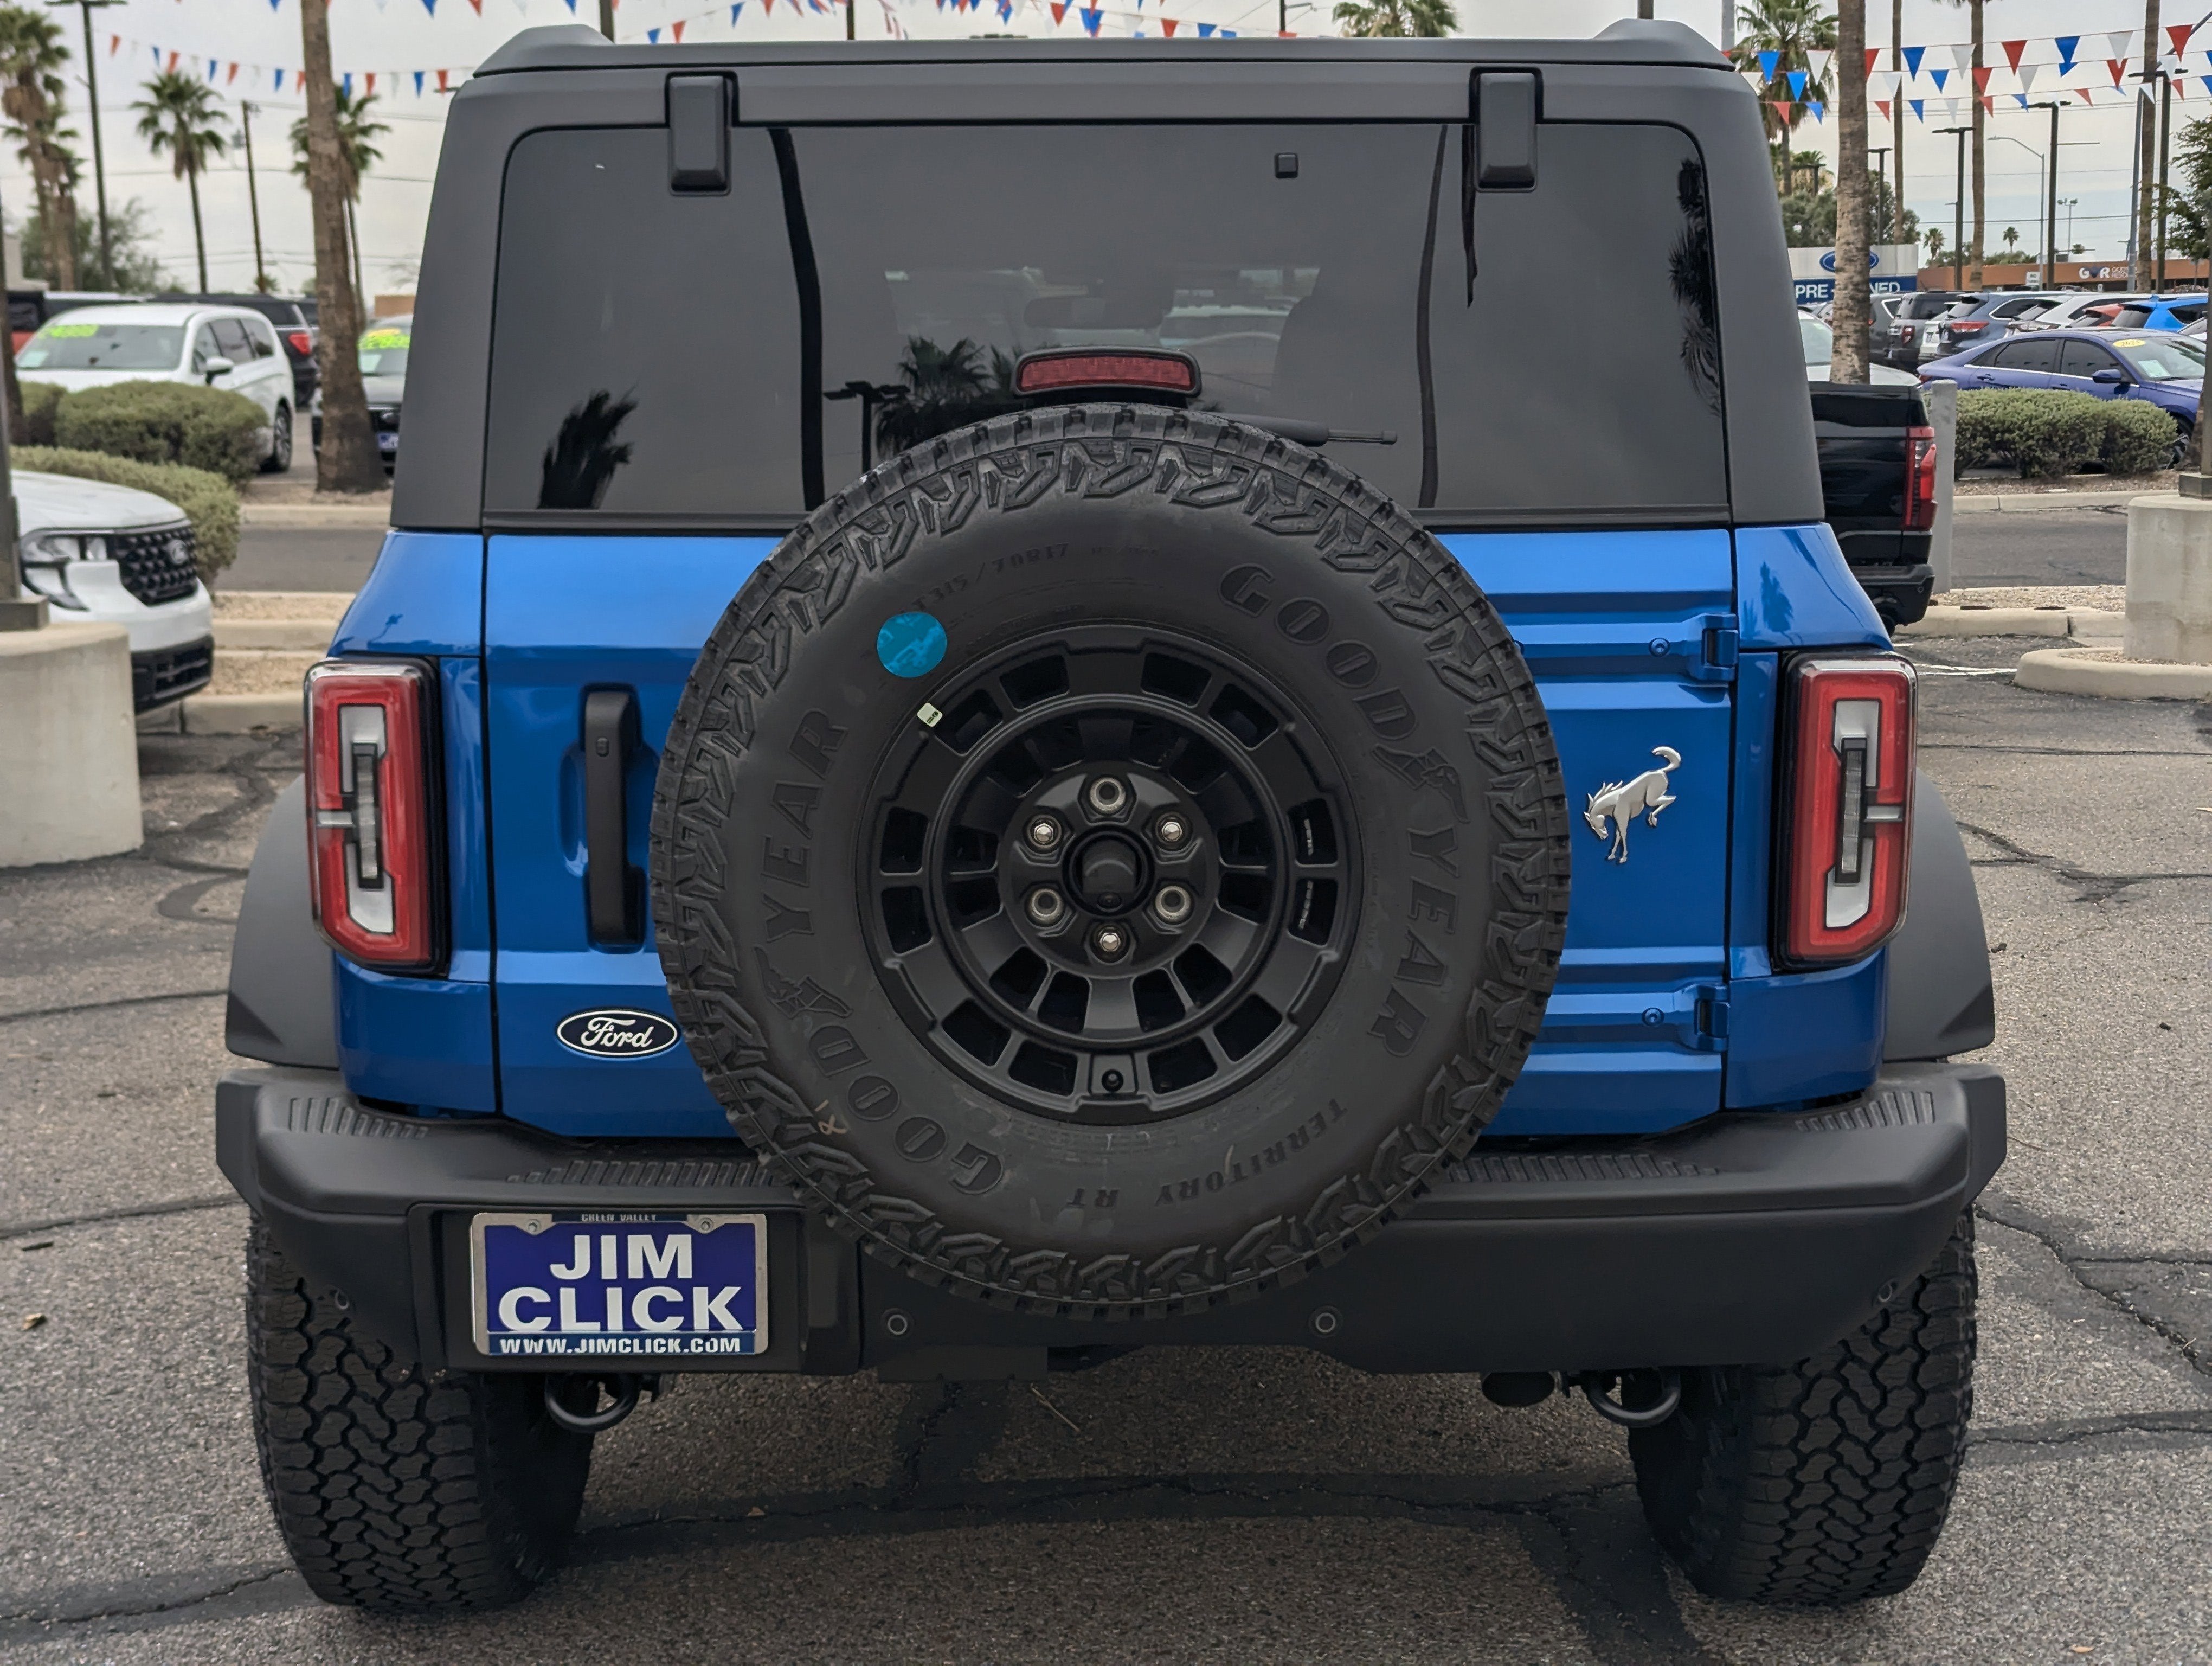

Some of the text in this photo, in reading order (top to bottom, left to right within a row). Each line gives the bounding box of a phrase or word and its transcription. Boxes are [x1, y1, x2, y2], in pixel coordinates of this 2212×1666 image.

[580, 1017, 655, 1048] Ford
[1069, 1098, 1348, 1208] TERRITORY RT
[620, 1214, 658, 1222] VALLEY
[549, 1234, 693, 1280] JIM
[498, 1286, 744, 1331] CLICK
[500, 1338, 741, 1354] WWW.JIMCLICK.COM
